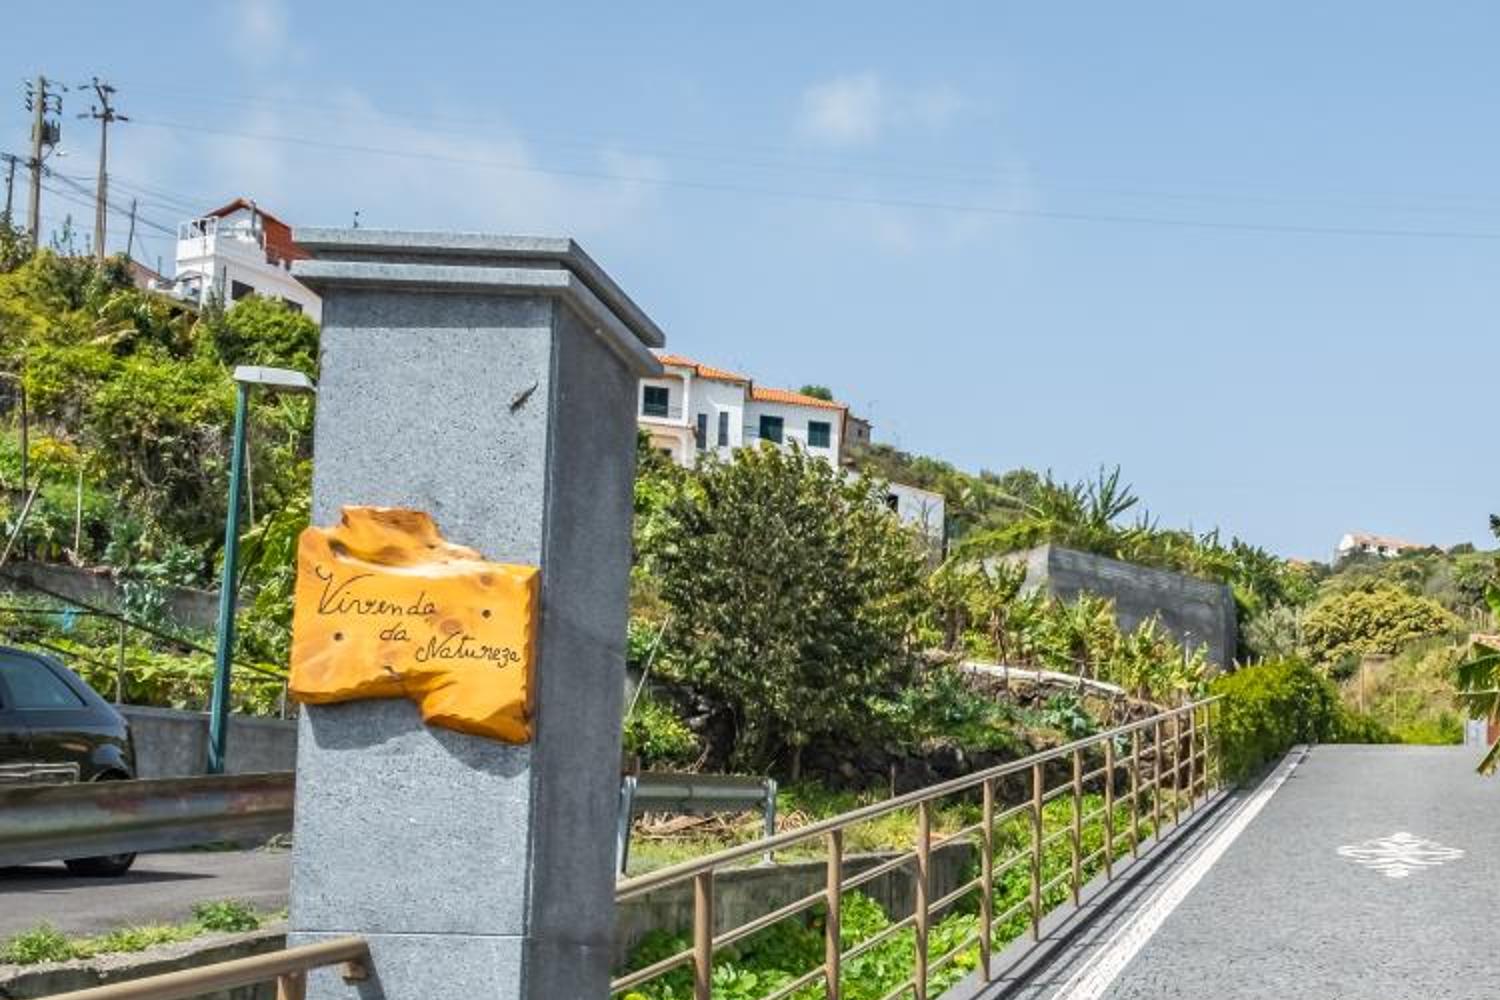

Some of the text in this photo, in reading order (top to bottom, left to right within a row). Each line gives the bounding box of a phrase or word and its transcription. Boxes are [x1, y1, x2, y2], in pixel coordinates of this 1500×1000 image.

[315, 565, 436, 615] Vivenda
[379, 622, 411, 641] da
[415, 631, 521, 668] Natureza
